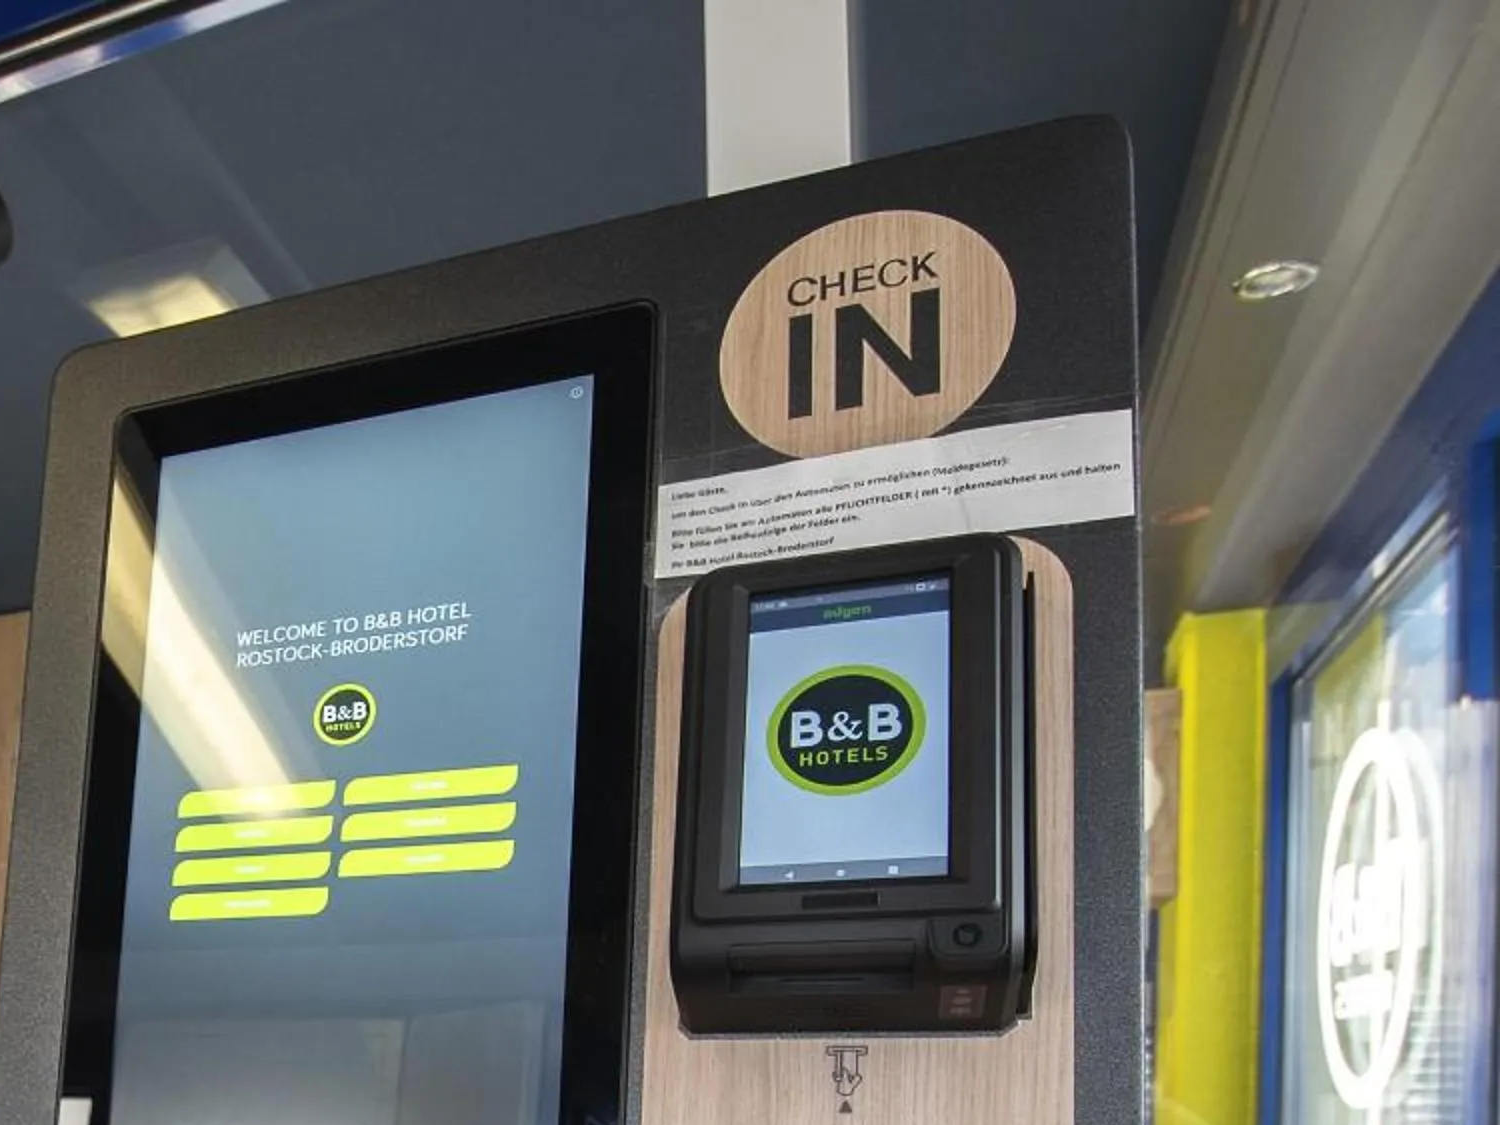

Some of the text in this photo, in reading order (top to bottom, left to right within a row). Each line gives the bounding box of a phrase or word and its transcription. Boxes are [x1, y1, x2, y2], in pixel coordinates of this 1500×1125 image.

[787, 251, 938, 307] CHECK
[788, 287, 941, 420] IN
[671, 490, 695, 501] Liebe
[671, 528, 693, 538] Bitte
[724, 522, 738, 531] Sie
[758, 509, 813, 526] Automaten
[815, 505, 833, 515] alle
[835, 490, 913, 511] PFLICHTFELDER
[1039, 471, 1058, 481] aus
[1060, 467, 1082, 478] und
[1084, 462, 1121, 475] halten
[688, 508, 706, 517] den
[708, 503, 735, 515] Check
[774, 492, 793, 503] den
[795, 483, 850, 498] Automaten
[853, 480, 865, 489] zu
[867, 470, 930, 487] ermöglichen
[686, 558, 707, 567] B&B
[709, 552, 735, 565] Hotel
[736, 536, 835, 560] Rostock-Broderstorf
[730, 526, 787, 543] Reihenfolge
[789, 522, 806, 532] der
[808, 517, 839, 529] Felder
[236, 602, 473, 648] WELCOME TO B&B HOTEL
[236, 624, 470, 668] ROSTOCK-BRODERSTORF
[322, 701, 368, 724] B&B
[325, 720, 362, 733] HOTELS
[790, 703, 903, 749] B&B
[799, 745, 888, 768] HOTELS
